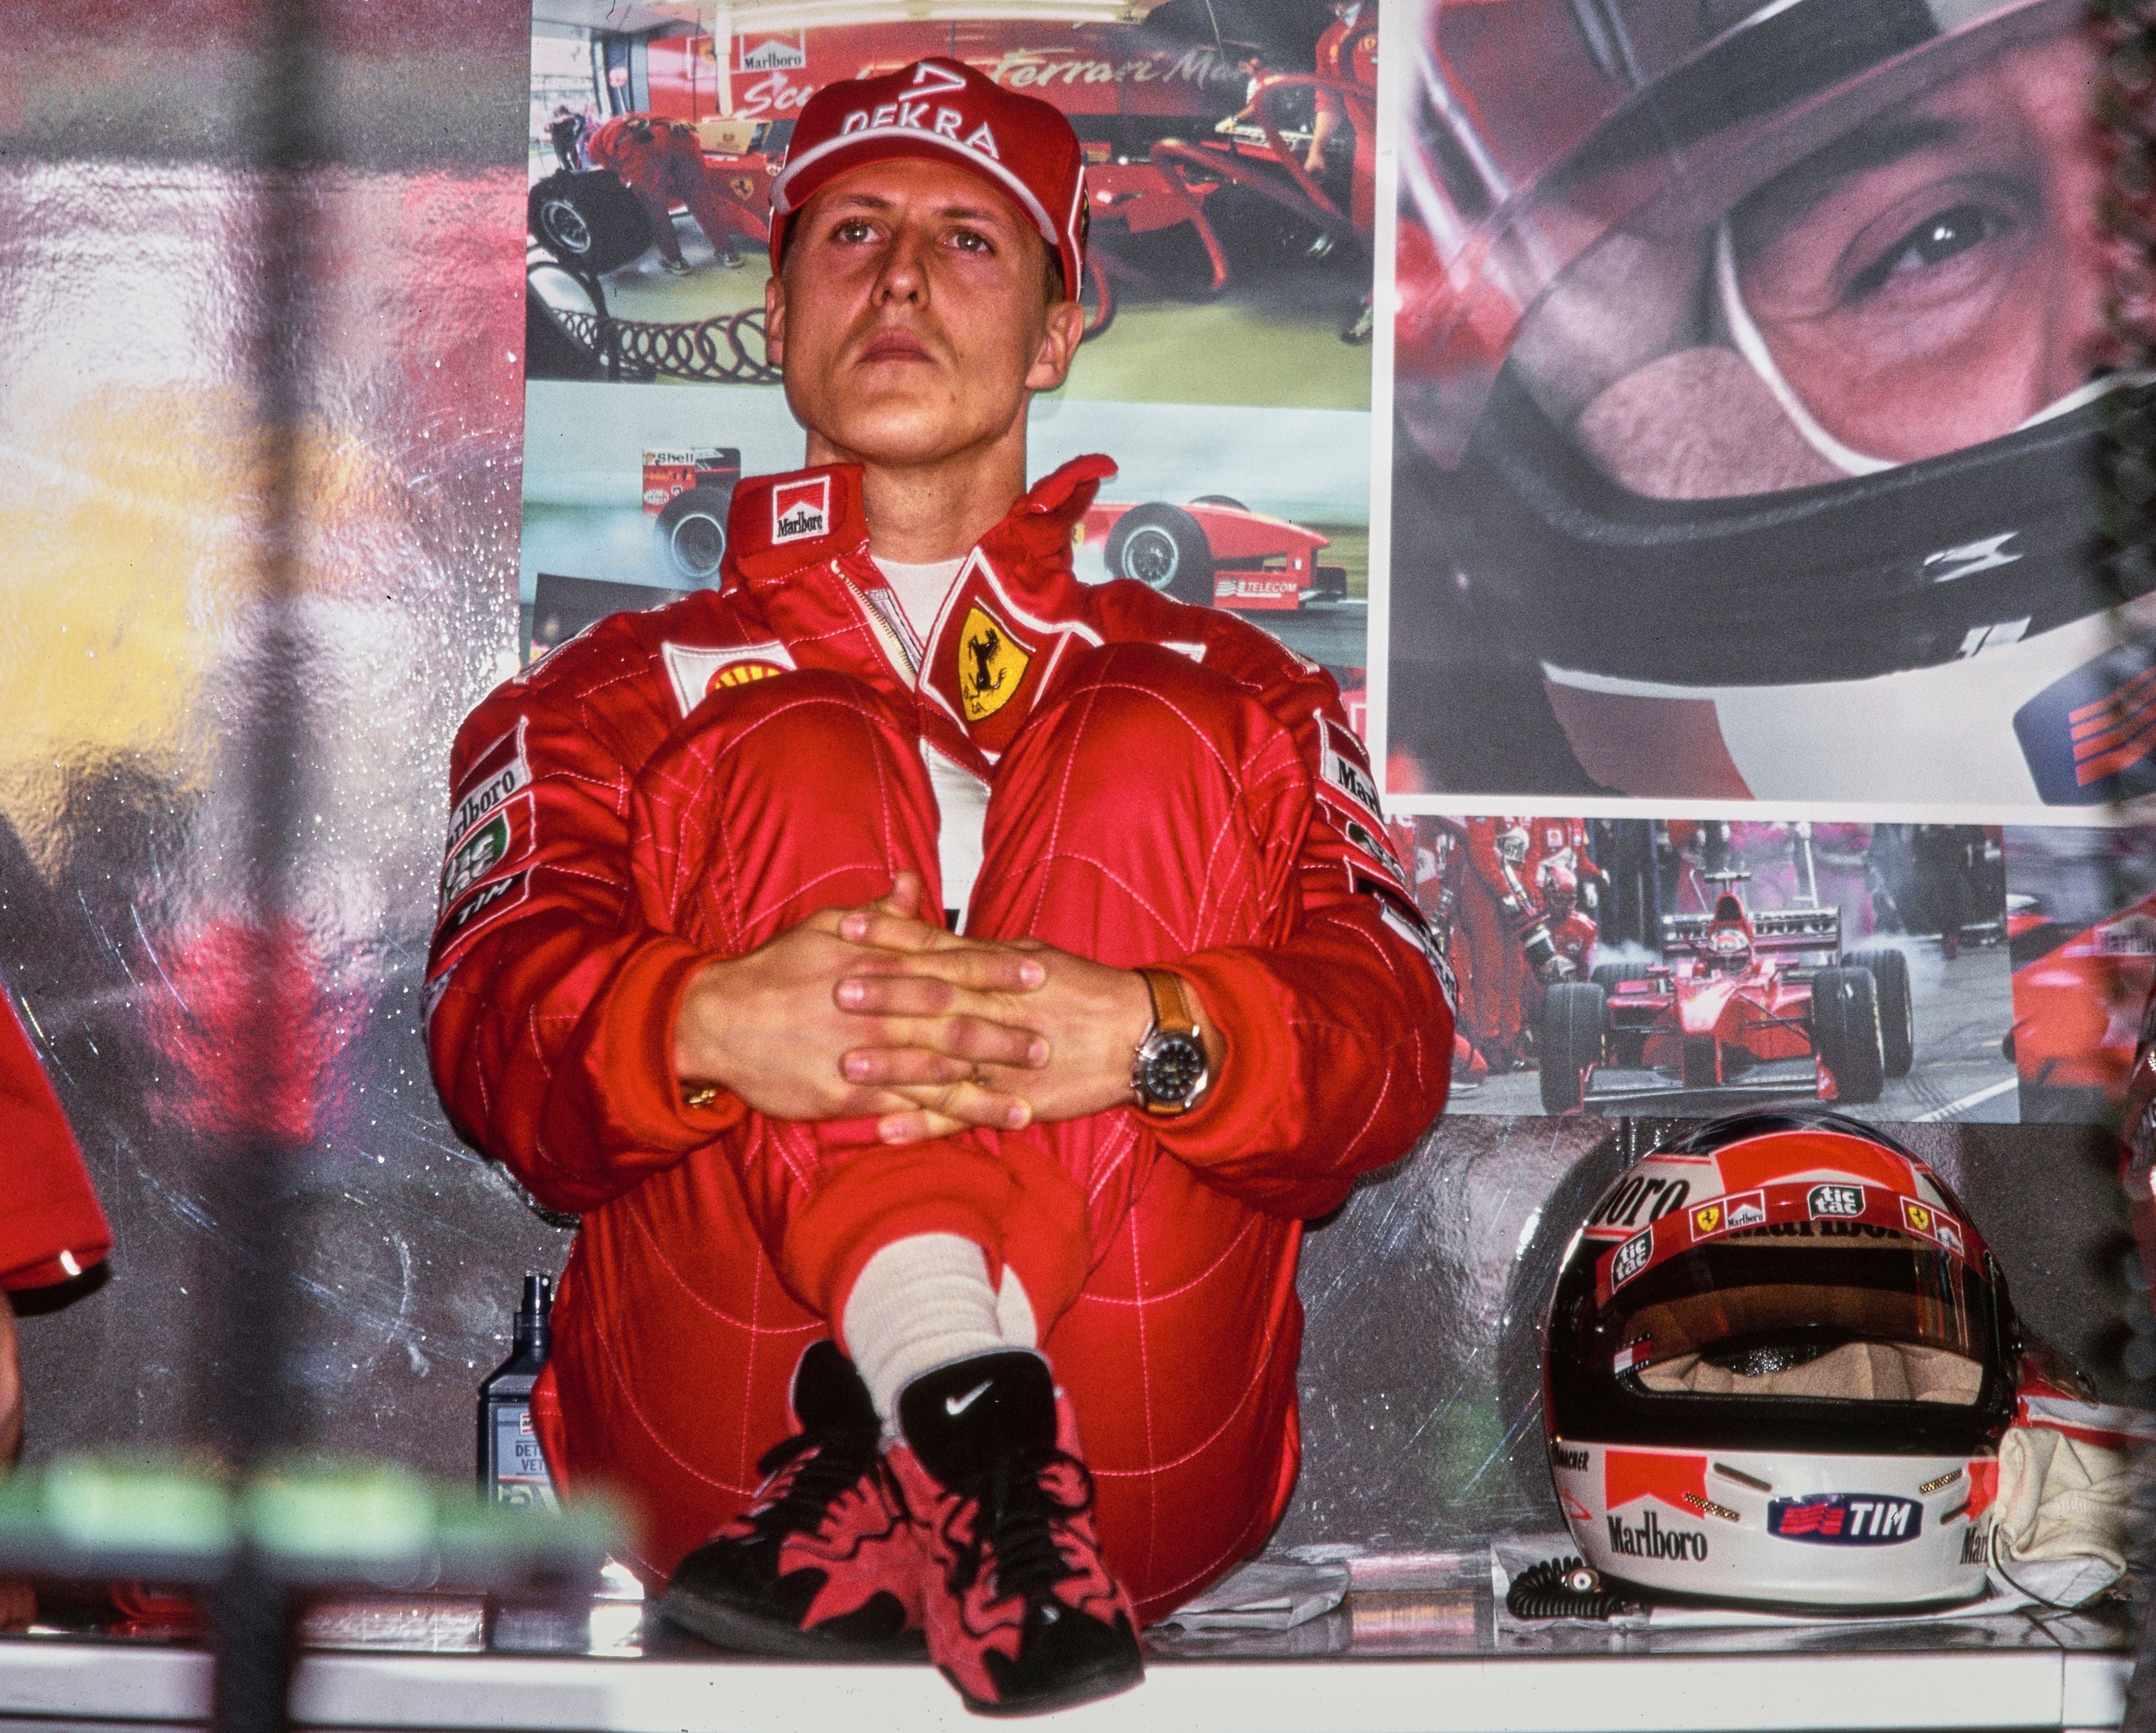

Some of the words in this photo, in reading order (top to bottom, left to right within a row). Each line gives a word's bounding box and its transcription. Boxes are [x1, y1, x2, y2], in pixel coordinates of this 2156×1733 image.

[744, 53, 802, 70] Marlboro
[842, 101, 1000, 160] DEKRA
[658, 453, 694, 463] Shell
[777, 511, 823, 538] Marlboro
[1247, 582, 1297, 593] TELECOM
[458, 878, 513, 925] TIM
[1815, 1198, 1857, 1215] tac
[1821, 1188, 1855, 1203] tic
[1727, 1213, 1763, 1228] Marlboro
[1619, 1238, 1646, 1263] tic
[1615, 1252, 1646, 1281] tac
[1850, 1502, 1912, 1536] TIM
[1607, 1510, 1708, 1562] Marlboro
